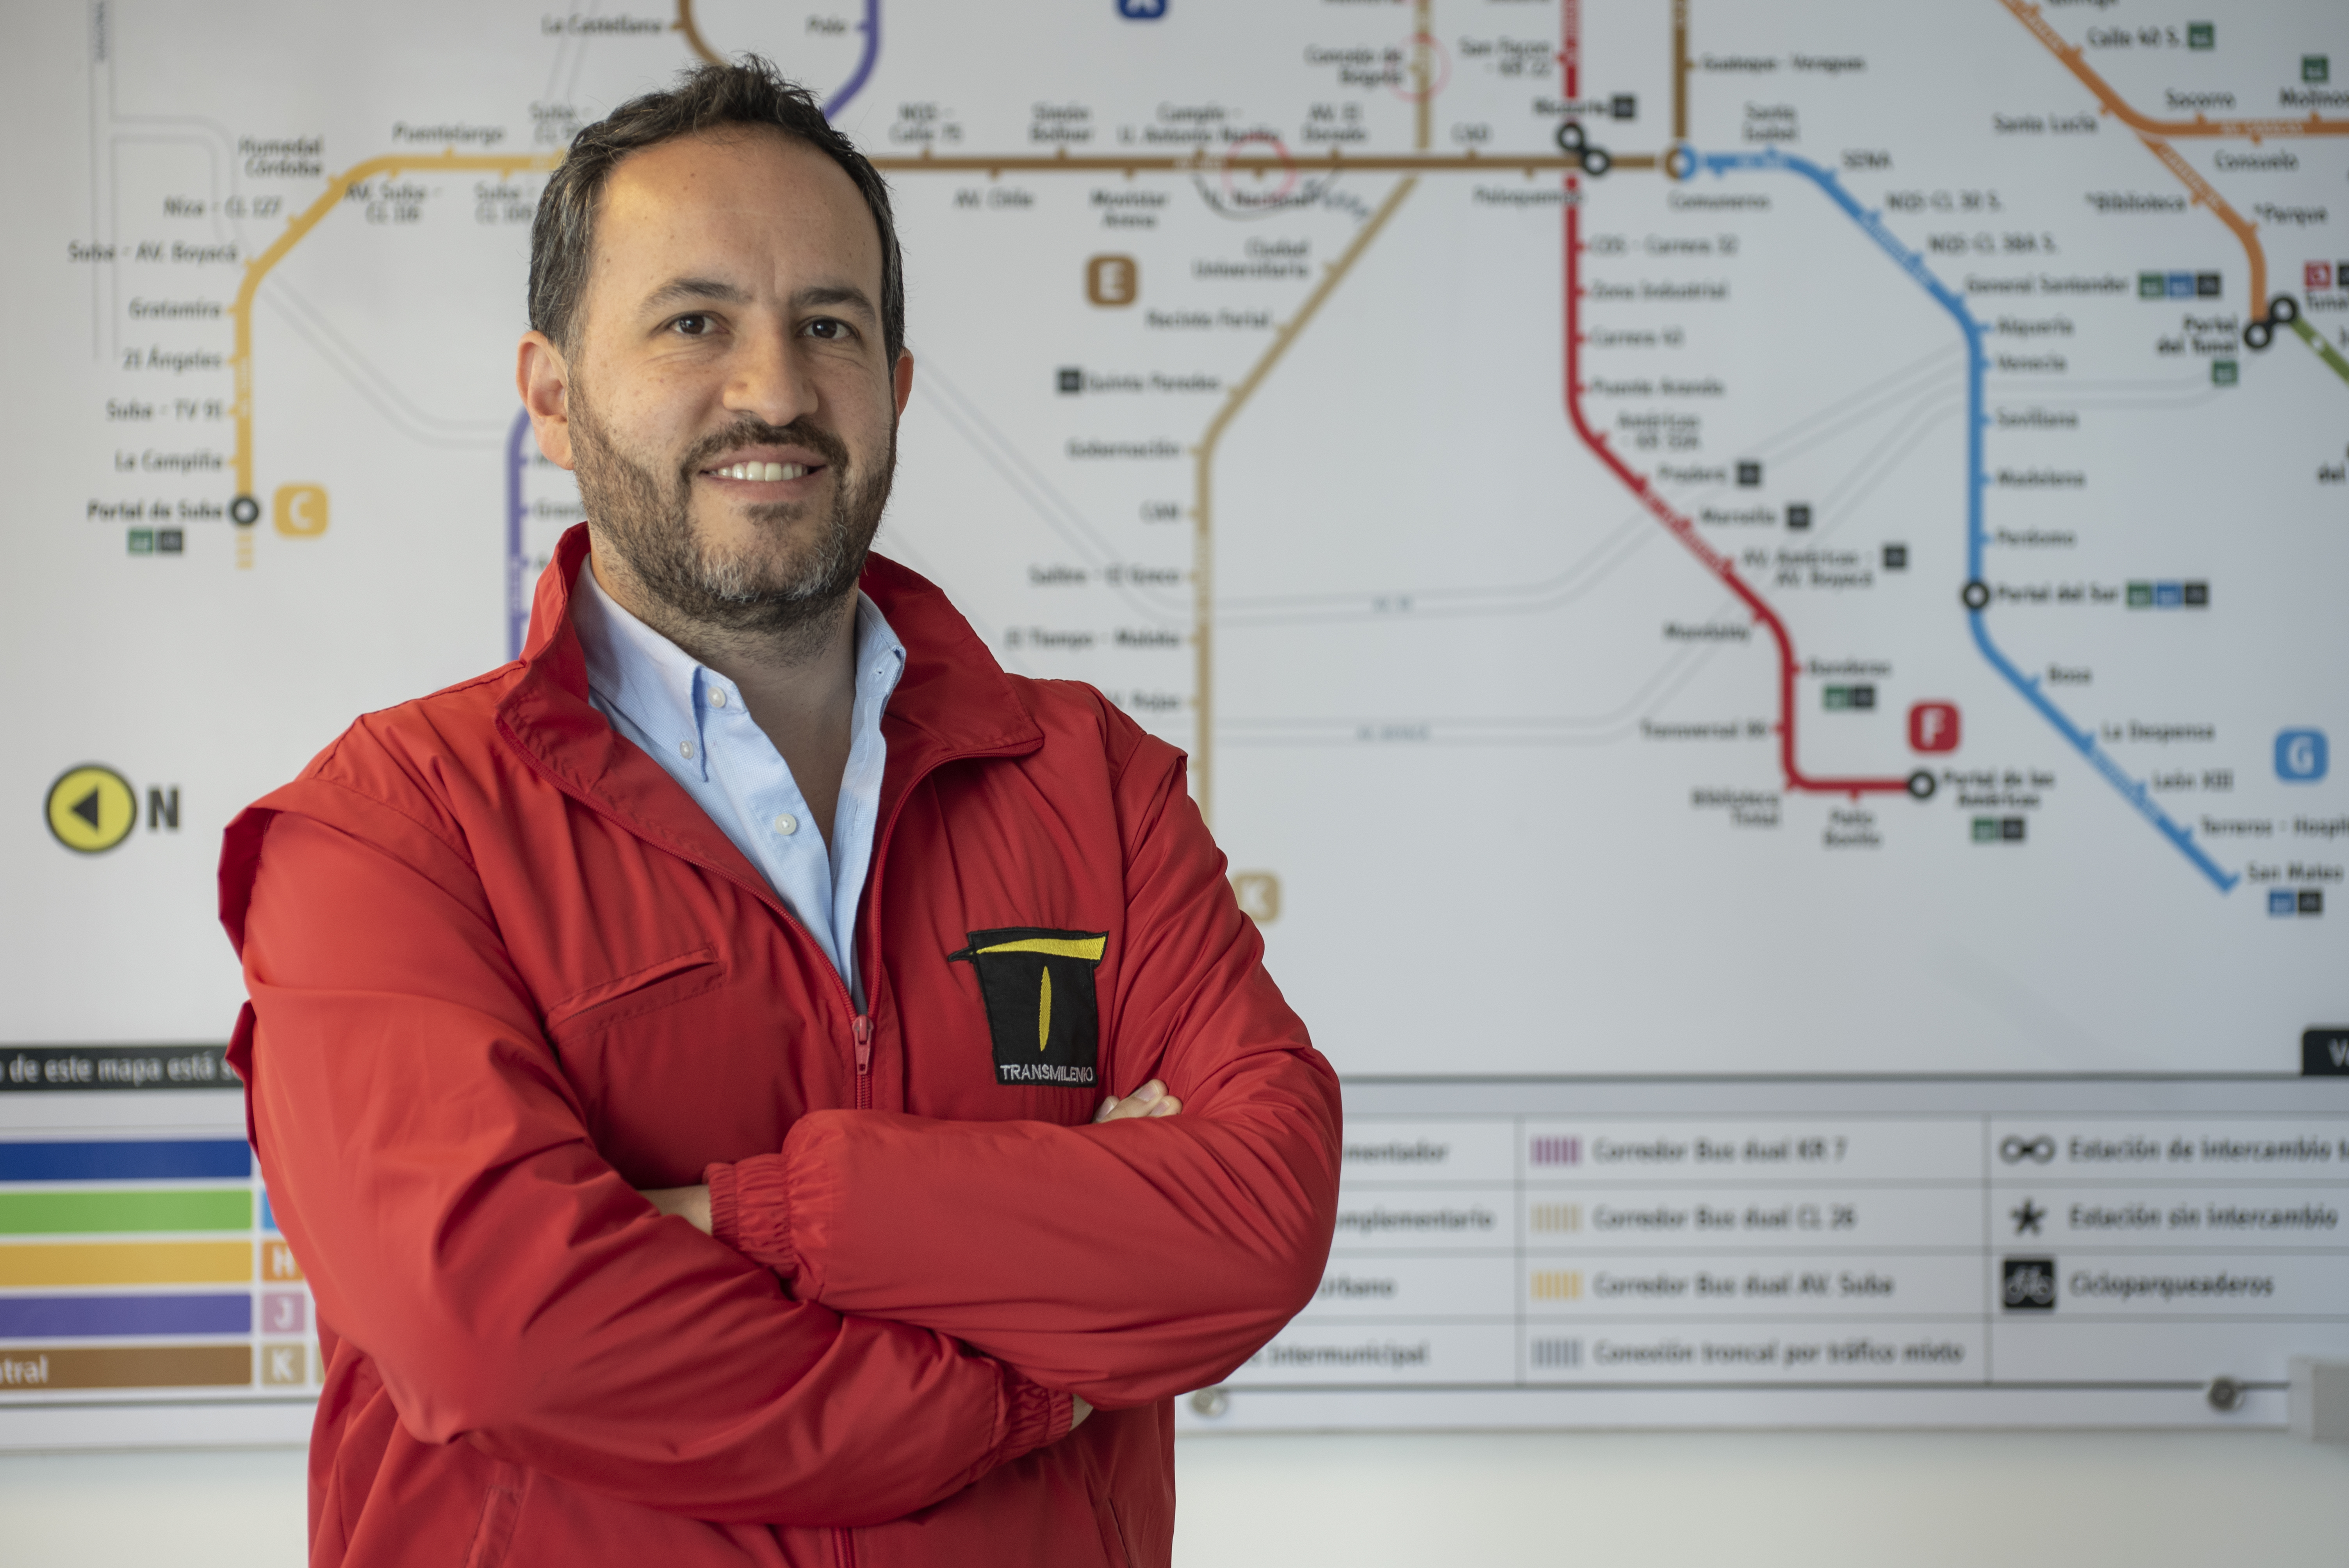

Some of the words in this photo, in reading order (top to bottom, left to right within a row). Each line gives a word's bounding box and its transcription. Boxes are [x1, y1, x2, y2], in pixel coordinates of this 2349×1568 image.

[1098, 261, 1126, 301] E
[288, 489, 315, 530] C
[1920, 707, 1948, 747] F
[2287, 734, 2316, 776] G
[148, 785, 182, 832] N
[8, 1052, 40, 1083] de
[45, 1052, 93, 1083] este
[98, 1057, 162, 1088] mapa
[167, 1049, 216, 1082] está
[1000, 1063, 1093, 1084] TRANSMILENIO
[1592, 1136, 1689, 1165] Corredor
[1693, 1137, 1735, 1164] Bus
[1741, 1135, 1790, 1164] dual
[2067, 1135, 2162, 1162] Estación
[2167, 1137, 2193, 1161] de
[2201, 1135, 2332, 1162] intercambio
[1592, 1204, 1689, 1233] Corredor
[1693, 1204, 1735, 1232] Bus
[1741, 1203, 1790, 1230] dual
[2067, 1203, 2162, 1231] Estación
[2168, 1203, 2201, 1231] sin
[2206, 1203, 2339, 1231] intercambio
[271, 1244, 296, 1279] H
[1592, 1271, 1689, 1299] Corredor
[1693, 1271, 1735, 1299] Bus
[1741, 1270, 1790, 1298] dual
[1838, 1270, 1896, 1299] Suba
[2069, 1269, 2276, 1305] Cicloparqueaderos
[271, 1349, 295, 1383] K
[1592, 1337, 1695, 1367] Conexión
[1783, 1341, 1821, 1370] por
